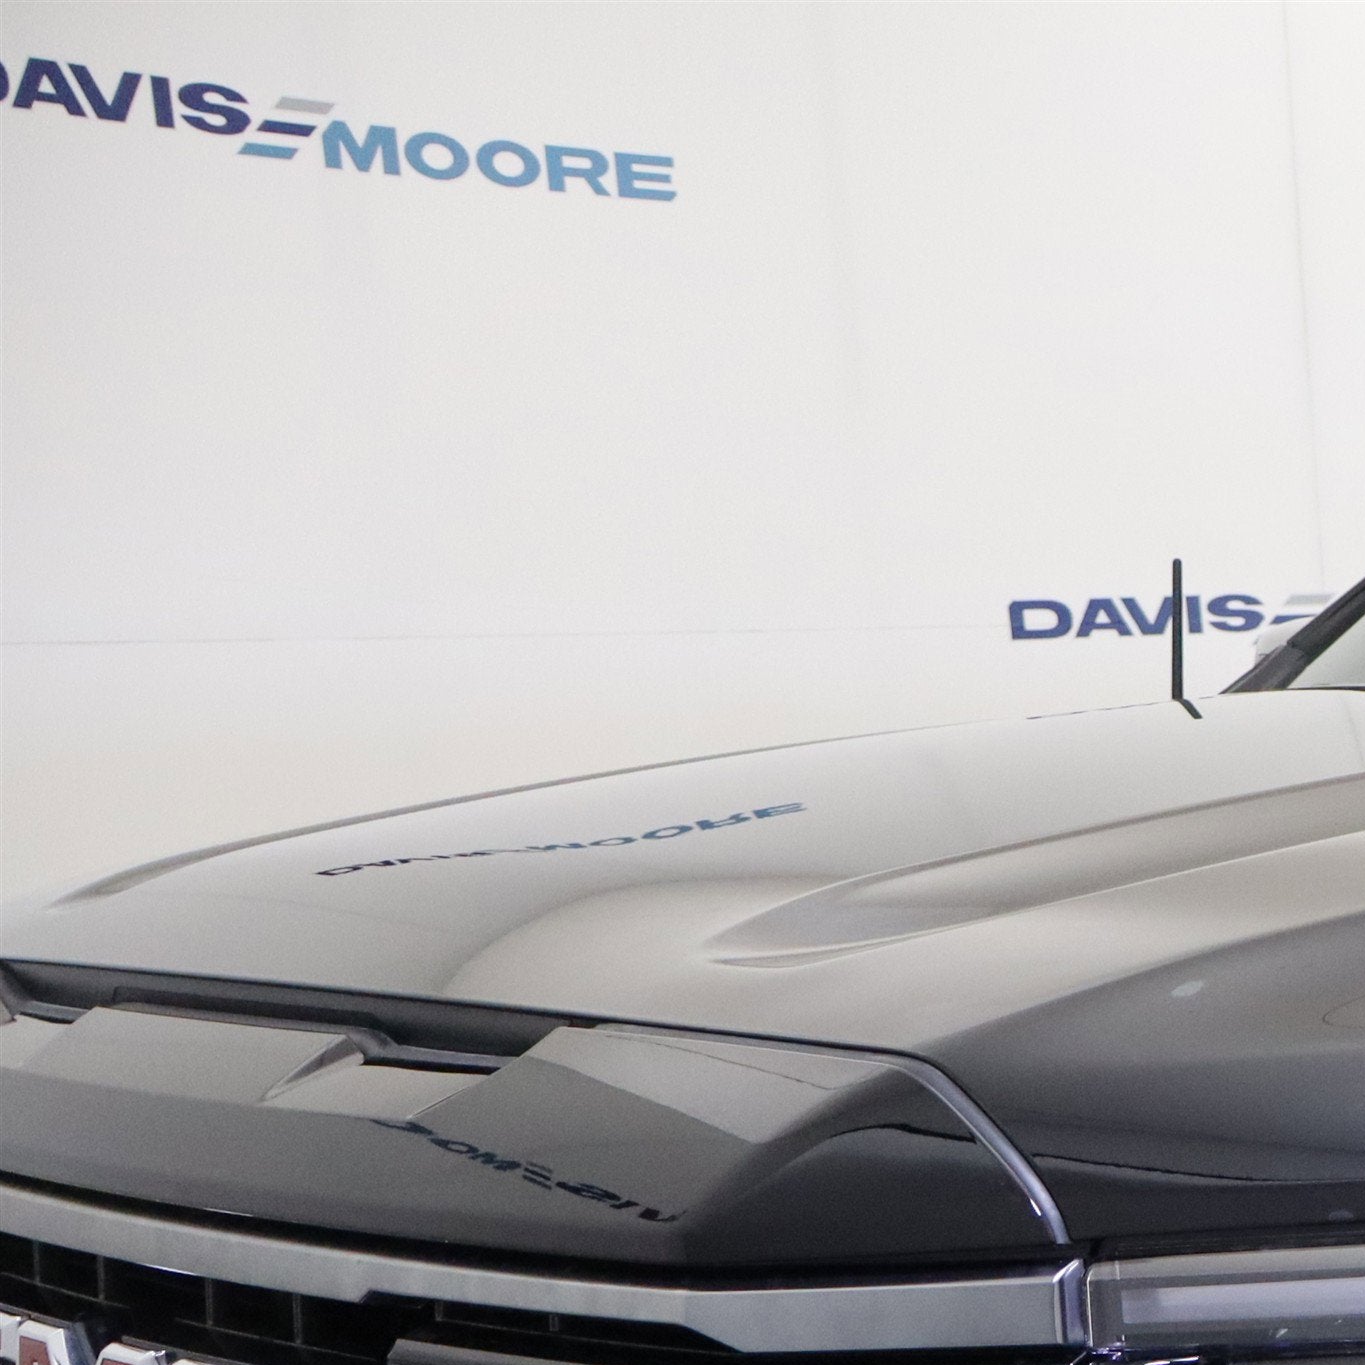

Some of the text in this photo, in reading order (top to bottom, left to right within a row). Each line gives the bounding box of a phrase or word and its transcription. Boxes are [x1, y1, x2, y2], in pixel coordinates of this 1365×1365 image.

[0, 56, 678, 202] AVIS MOORE
[1008, 593, 1265, 641] DAVIS
